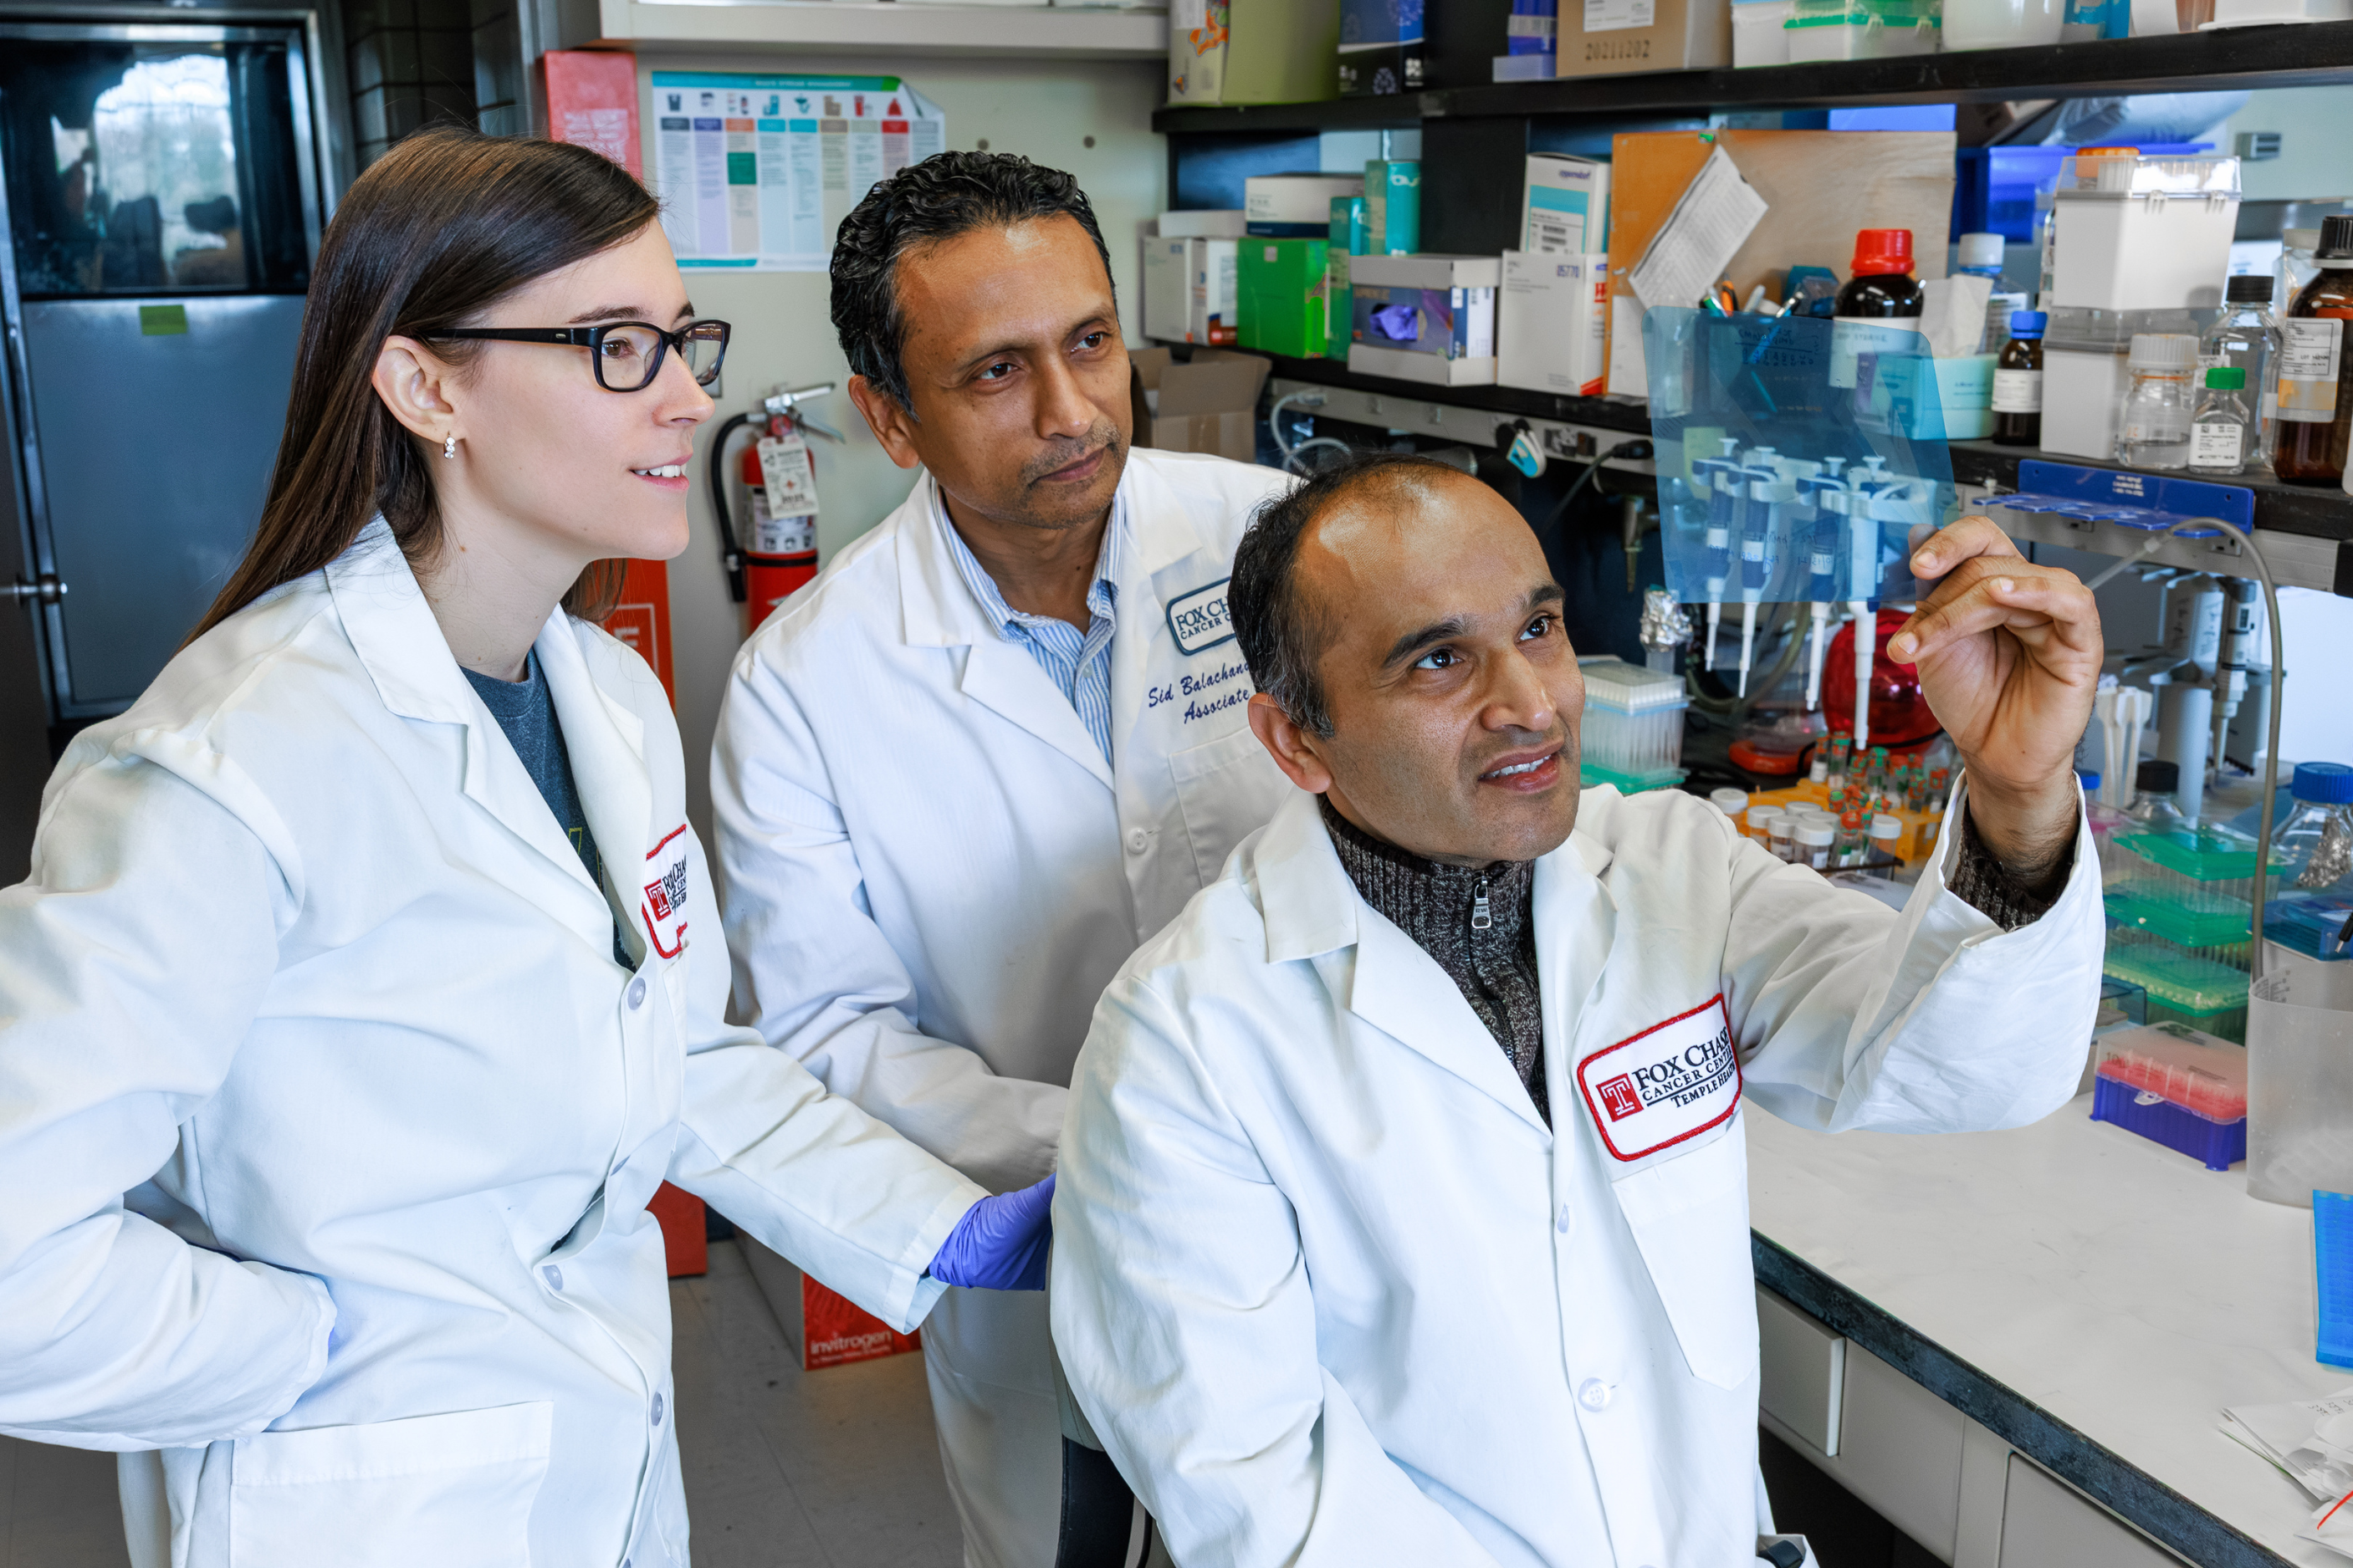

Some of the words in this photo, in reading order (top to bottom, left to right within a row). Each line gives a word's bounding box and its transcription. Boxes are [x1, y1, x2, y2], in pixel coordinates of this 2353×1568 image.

[1585, 39, 1650, 61] 20211202
[1174, 605, 1208, 631] FOX
[1206, 595, 1230, 617] CH
[1180, 616, 1222, 640] CANCER
[1148, 683, 1174, 707] Sid
[1184, 687, 1250, 724] Associate
[1632, 1055, 1686, 1091] FOX
[1684, 1026, 1730, 1067] CHASE
[1642, 1069, 1703, 1101] CANCER
[1706, 1045, 1733, 1074] CENTER
[1670, 1080, 1718, 1108] TEMPLE
[810, 1330, 893, 1356] invitrogen
